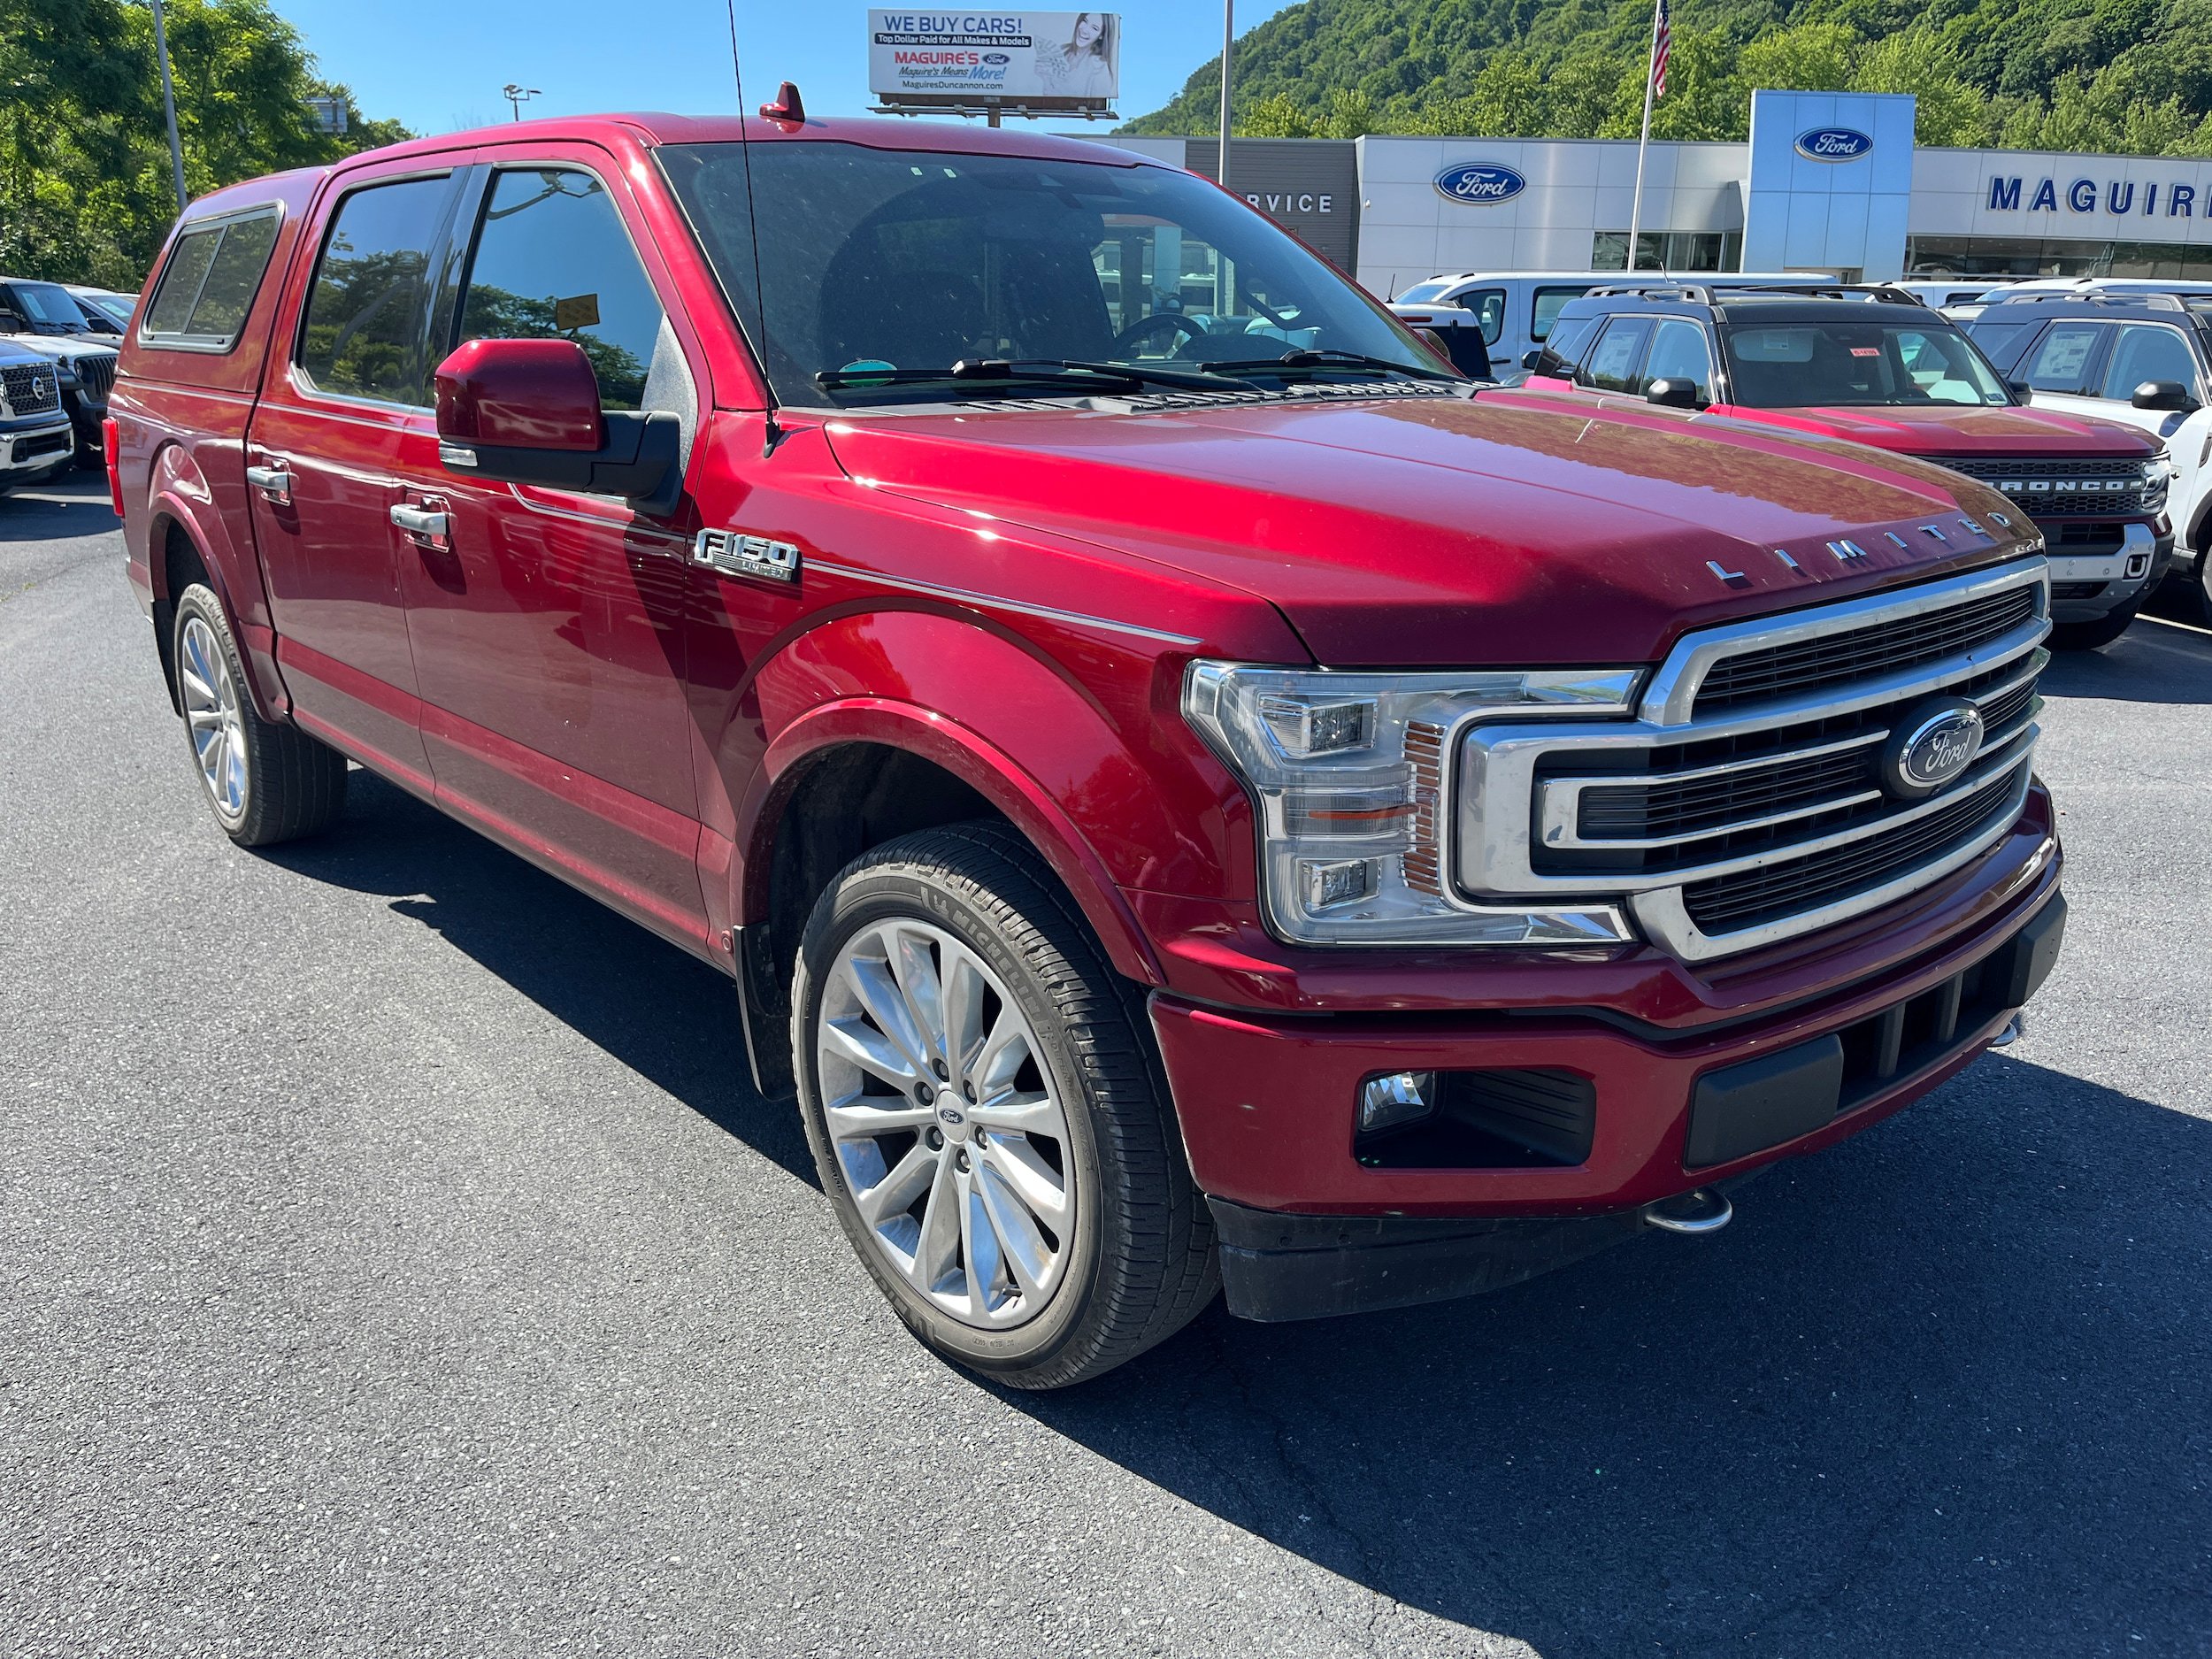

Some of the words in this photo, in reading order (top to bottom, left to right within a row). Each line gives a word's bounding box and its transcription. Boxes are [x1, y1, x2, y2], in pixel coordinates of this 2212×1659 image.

[884, 15, 914, 32] WE
[919, 16, 959, 33] BUY
[964, 17, 1022, 34] CARS!
[878, 35, 894, 43] Top
[999, 37, 1029, 46] Models
[895, 50, 979, 65] MAGUIRE'S
[899, 66, 939, 78] Maguire's
[941, 66, 969, 76] Means
[968, 65, 1007, 80] More!
[902, 81, 1003, 90] MaguiresDuncannon.com
[1814, 134, 1858, 155] Ford
[1455, 171, 1509, 196] Ford
[1985, 480, 2124, 492] RONCO
[1705, 511, 2011, 581] LIMITED
[1924, 729, 1972, 773] Ford
[952, 909, 1041, 1017] MICHELIN
[942, 1110, 960, 1123] Ford
